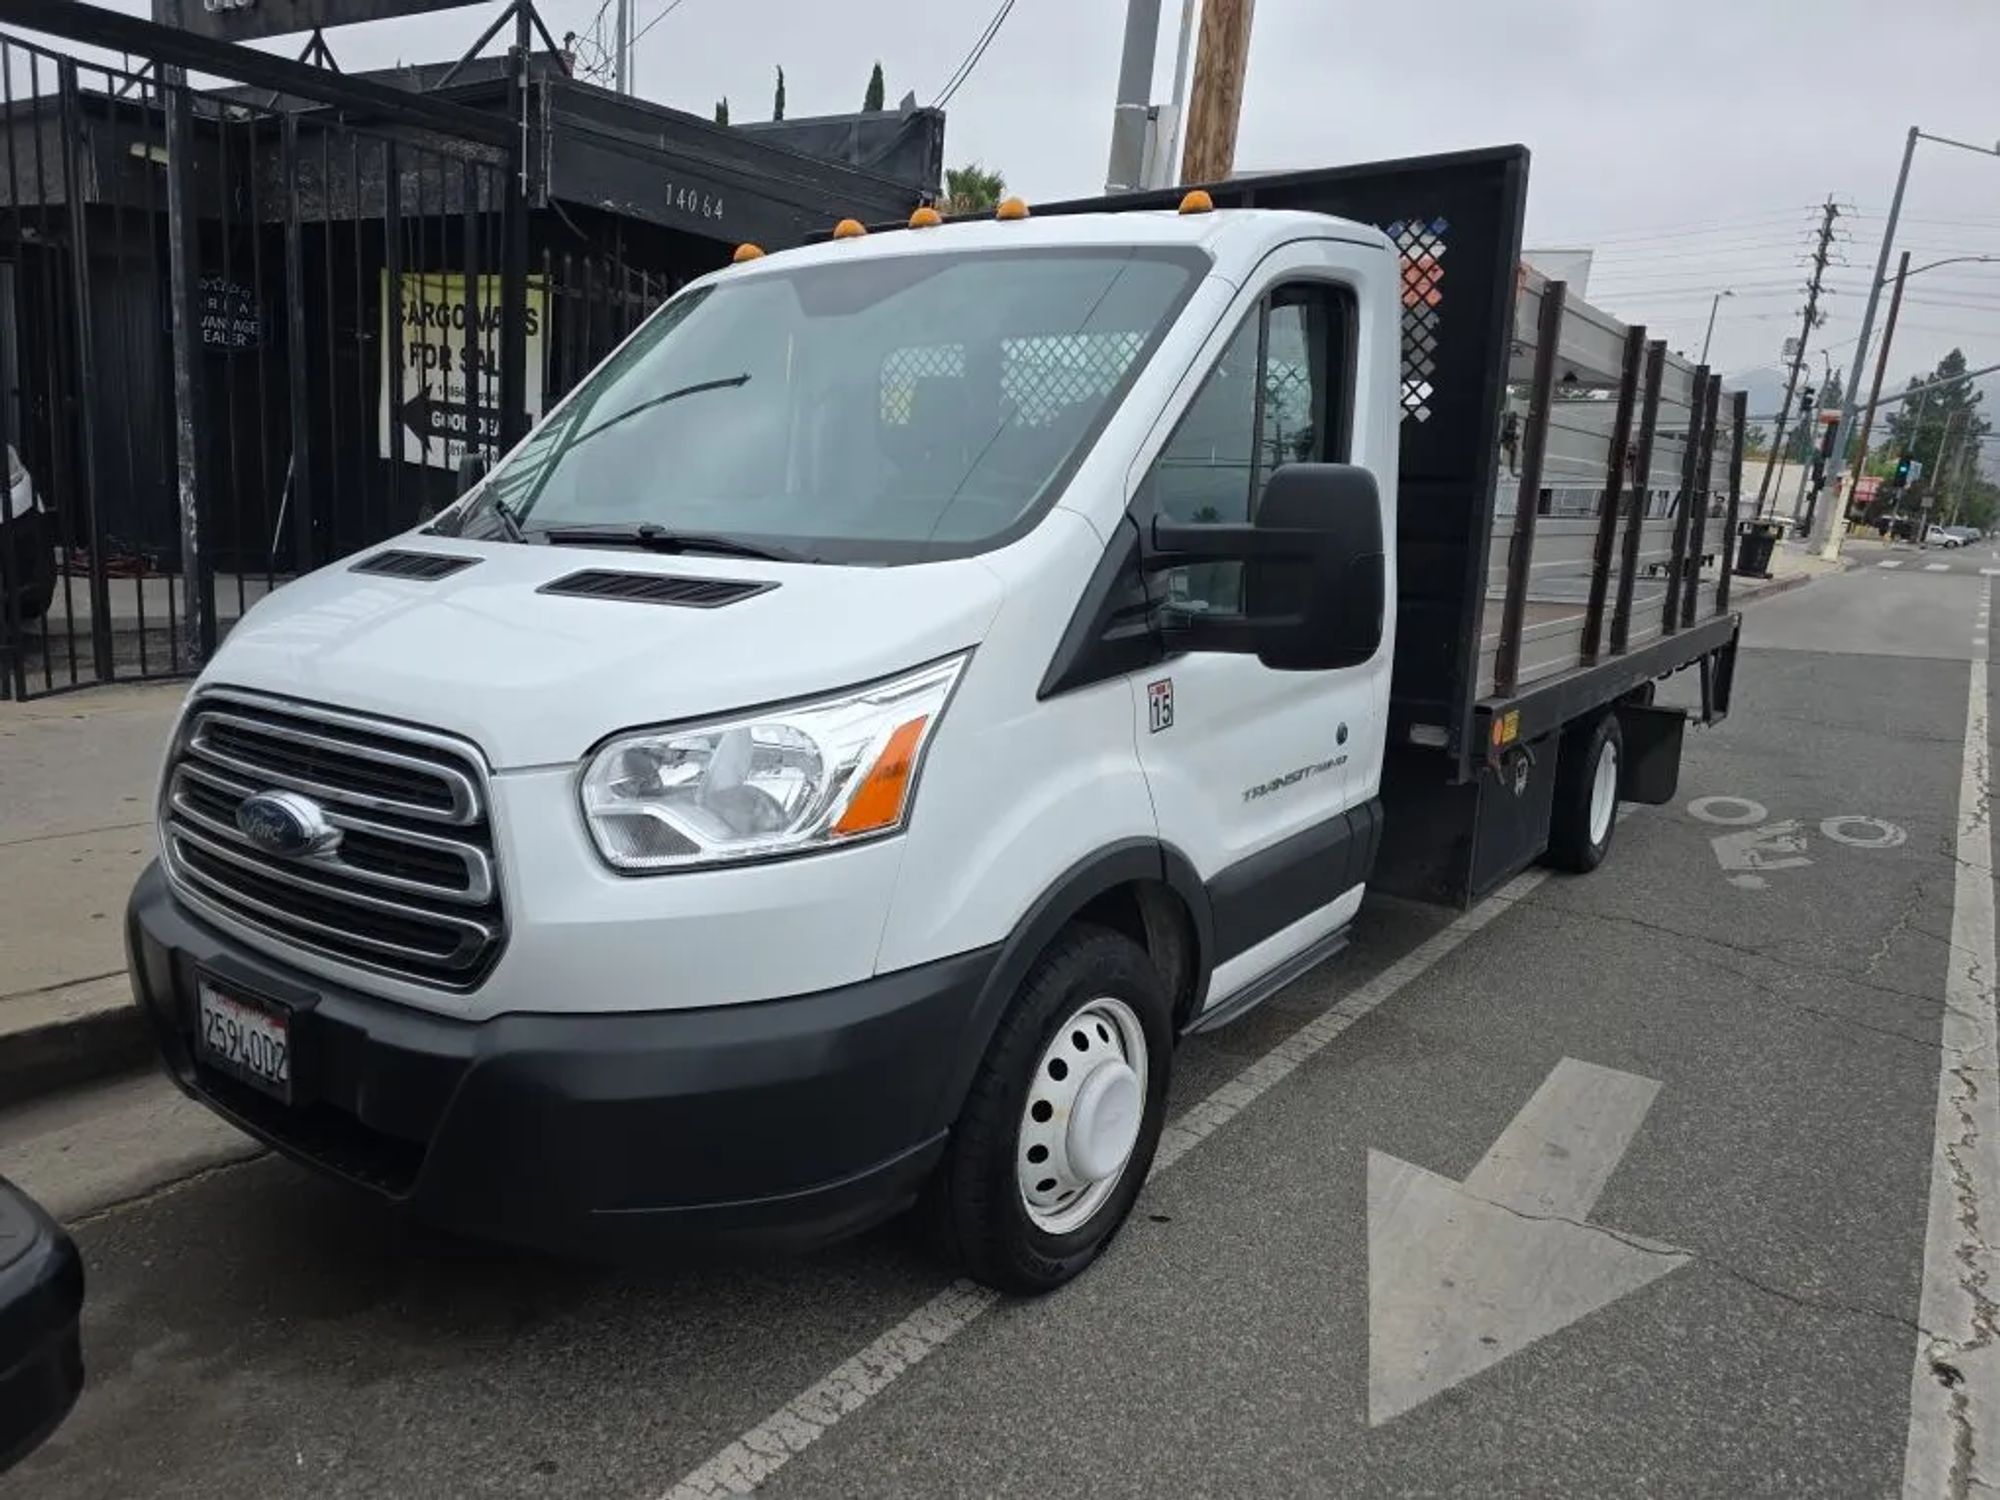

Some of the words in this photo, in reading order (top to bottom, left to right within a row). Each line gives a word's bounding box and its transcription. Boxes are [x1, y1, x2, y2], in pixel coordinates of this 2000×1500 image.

[666, 184, 723, 220] 14064
[202, 329, 247, 347] EALER
[476, 306, 539, 337] VAS
[410, 342, 452, 371] FOR
[459, 347, 501, 378] SAL
[1153, 694, 1170, 727] 15
[1242, 764, 1311, 802] TRANSIT
